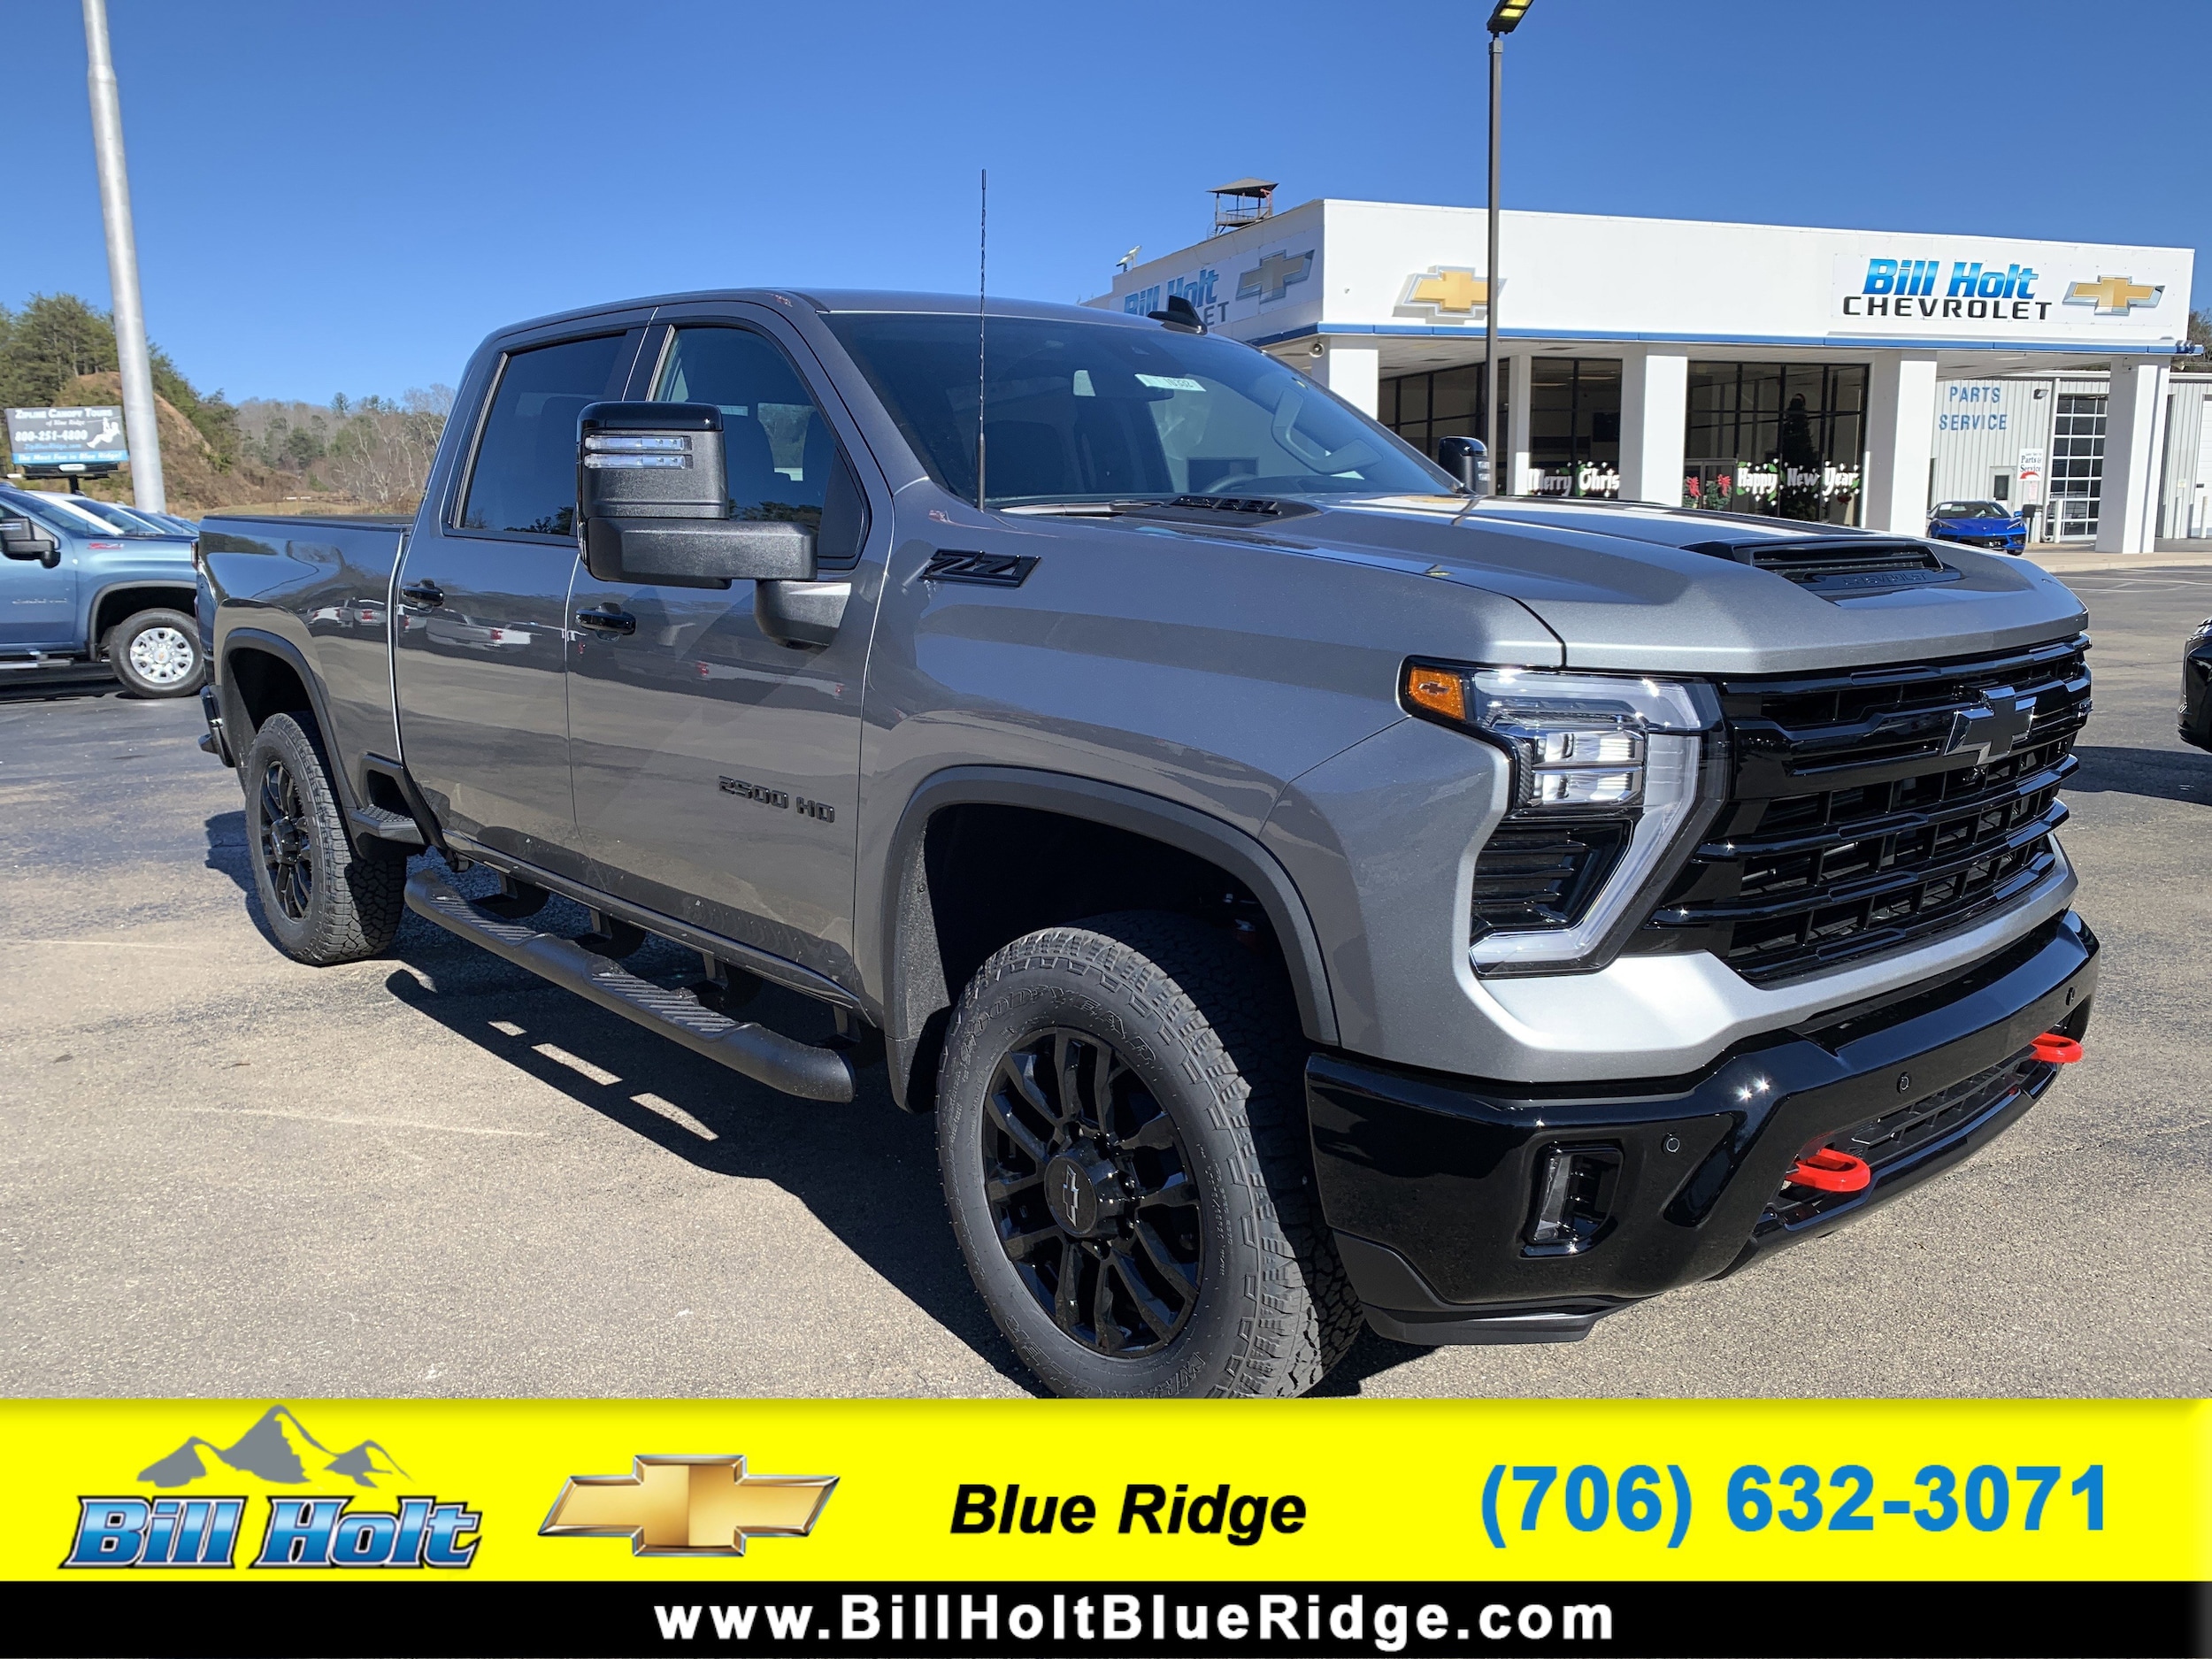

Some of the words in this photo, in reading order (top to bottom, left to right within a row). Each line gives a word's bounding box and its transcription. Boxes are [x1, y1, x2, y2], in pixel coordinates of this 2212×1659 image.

[1862, 258, 1939, 296] Bill
[1947, 262, 2039, 300] Holt
[1125, 285, 1160, 316] Bill
[1843, 296, 2052, 320] CHEVROLET
[1949, 386, 2001, 403] PARTS
[1939, 413, 2008, 431] SERVICE
[2020, 455, 2037, 464] Parts
[1528, 468, 1572, 496] Merry
[1578, 467, 1621, 490] Chris
[1737, 467, 1778, 495] Happy
[1787, 467, 1819, 487] New
[1823, 466, 1859, 495] Year
[718, 775, 789, 809] 2500
[795, 796, 835, 823] HD
